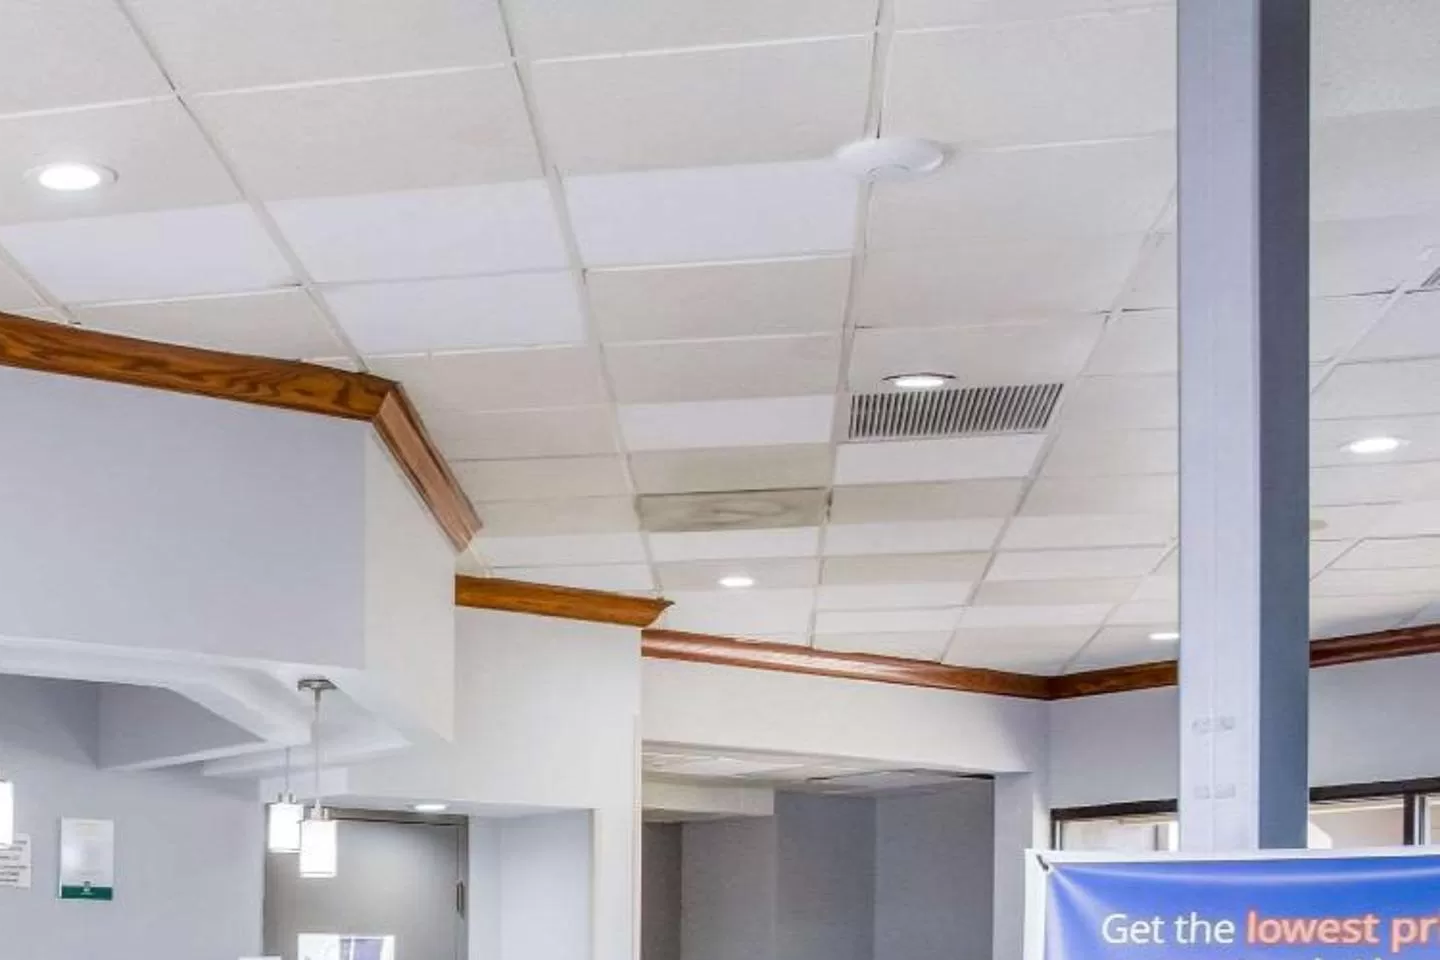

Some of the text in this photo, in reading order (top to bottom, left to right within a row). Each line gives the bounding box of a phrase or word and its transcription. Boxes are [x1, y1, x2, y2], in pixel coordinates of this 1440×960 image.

[1101, 910, 1440, 953] Get the lowest pr
